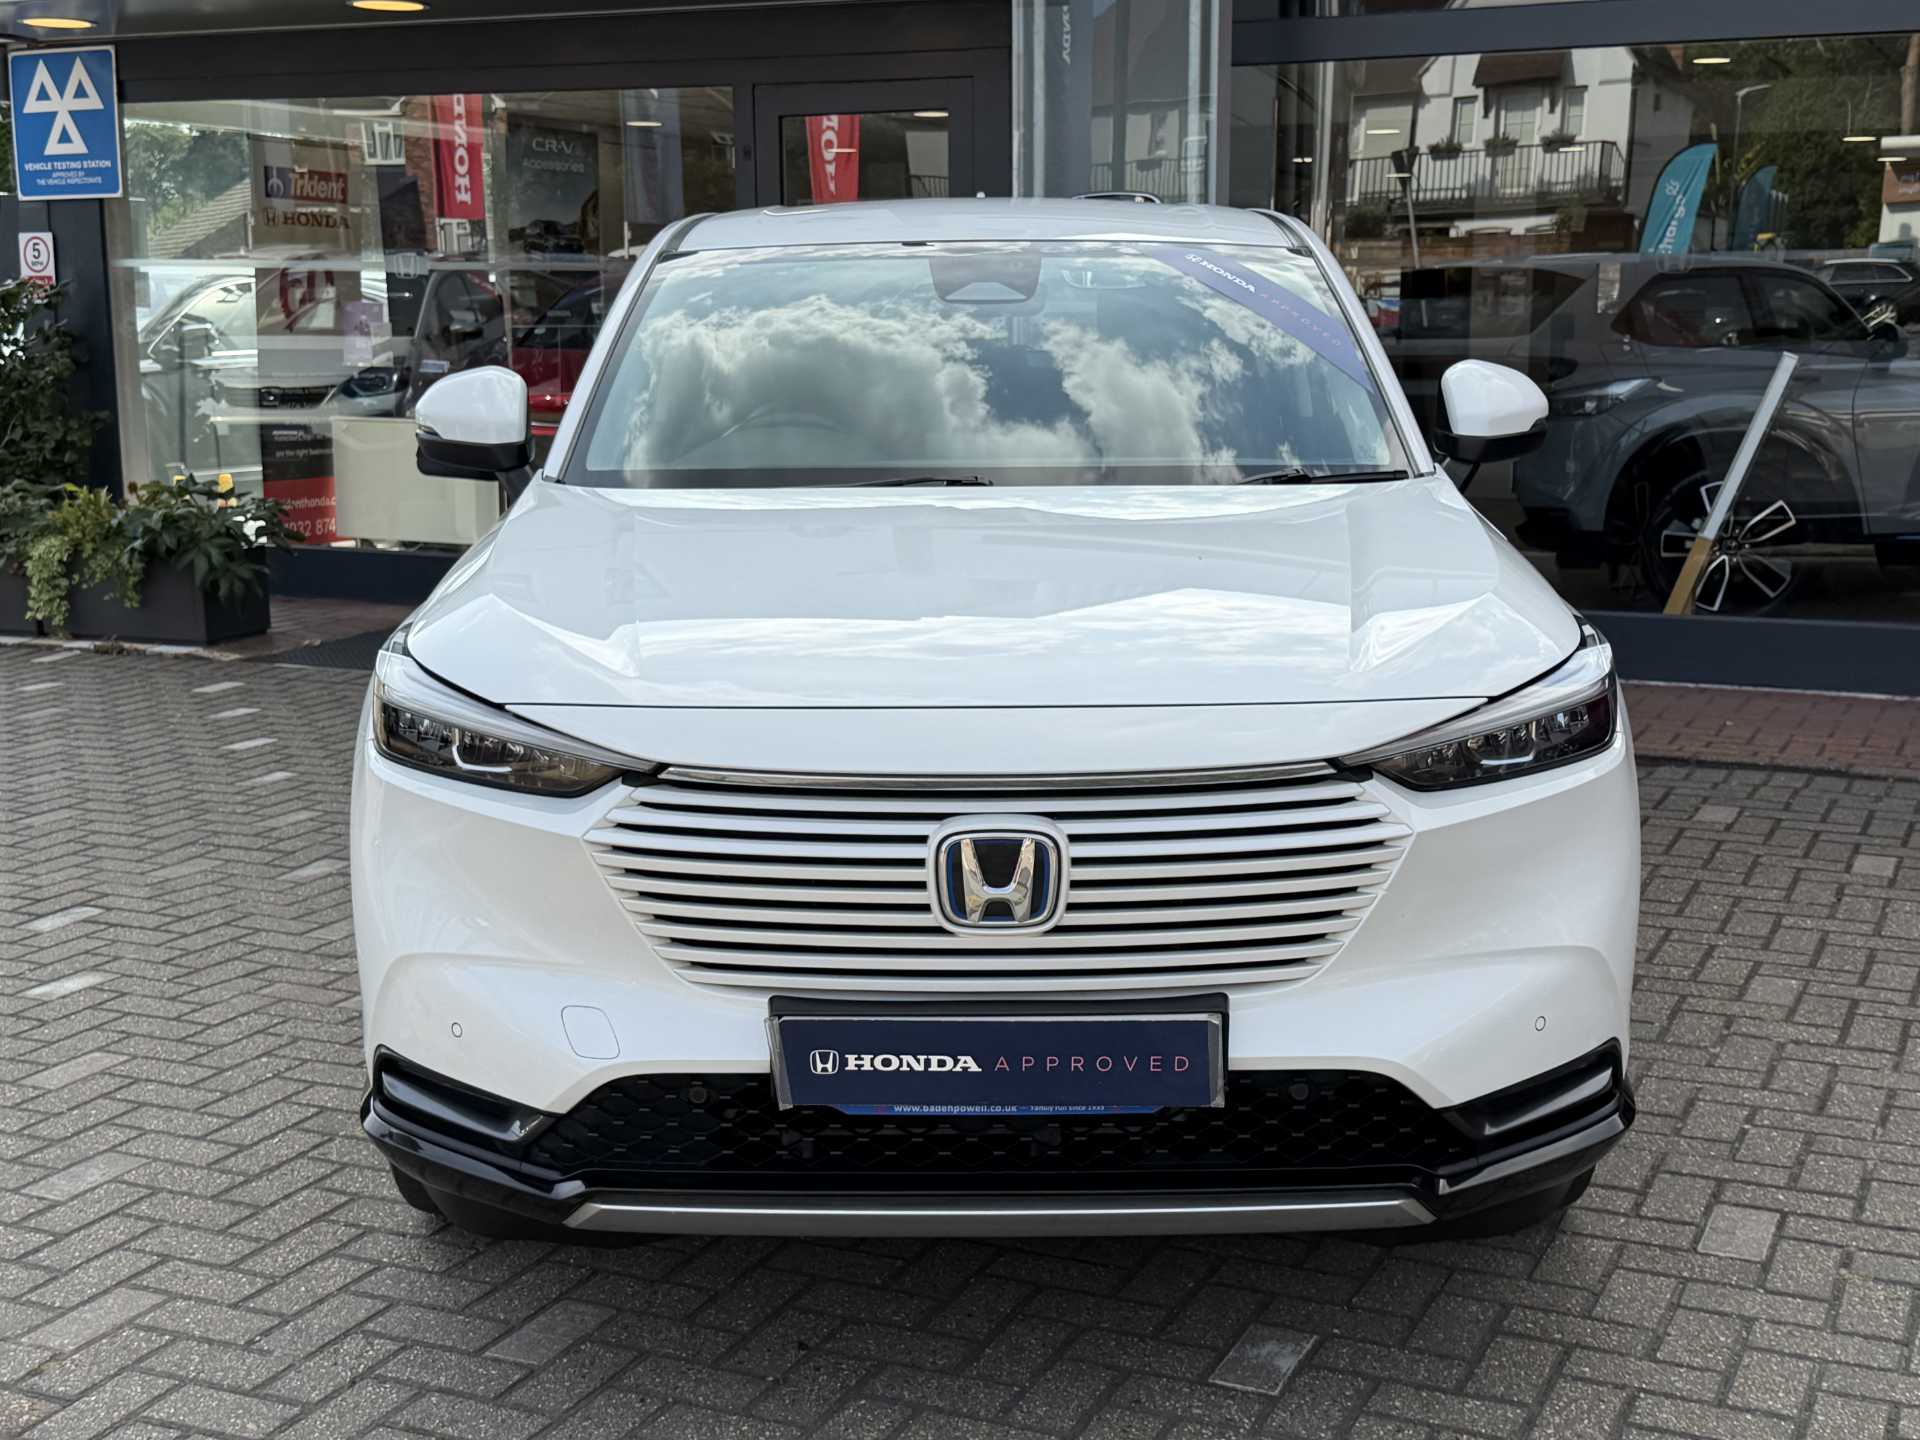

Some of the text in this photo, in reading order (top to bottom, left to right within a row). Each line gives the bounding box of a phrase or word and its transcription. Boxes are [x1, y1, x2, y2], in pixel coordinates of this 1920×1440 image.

[24, 160, 112, 171] VEHICLE TESTING STATION
[288, 171, 345, 200] Trident
[283, 211, 351, 229] HONDA
[32, 242, 42, 260] 5
[1200, 260, 1256, 293] HONDA
[845, 1053, 982, 1073] HONDA
[994, 1055, 1190, 1073] APPROVED
